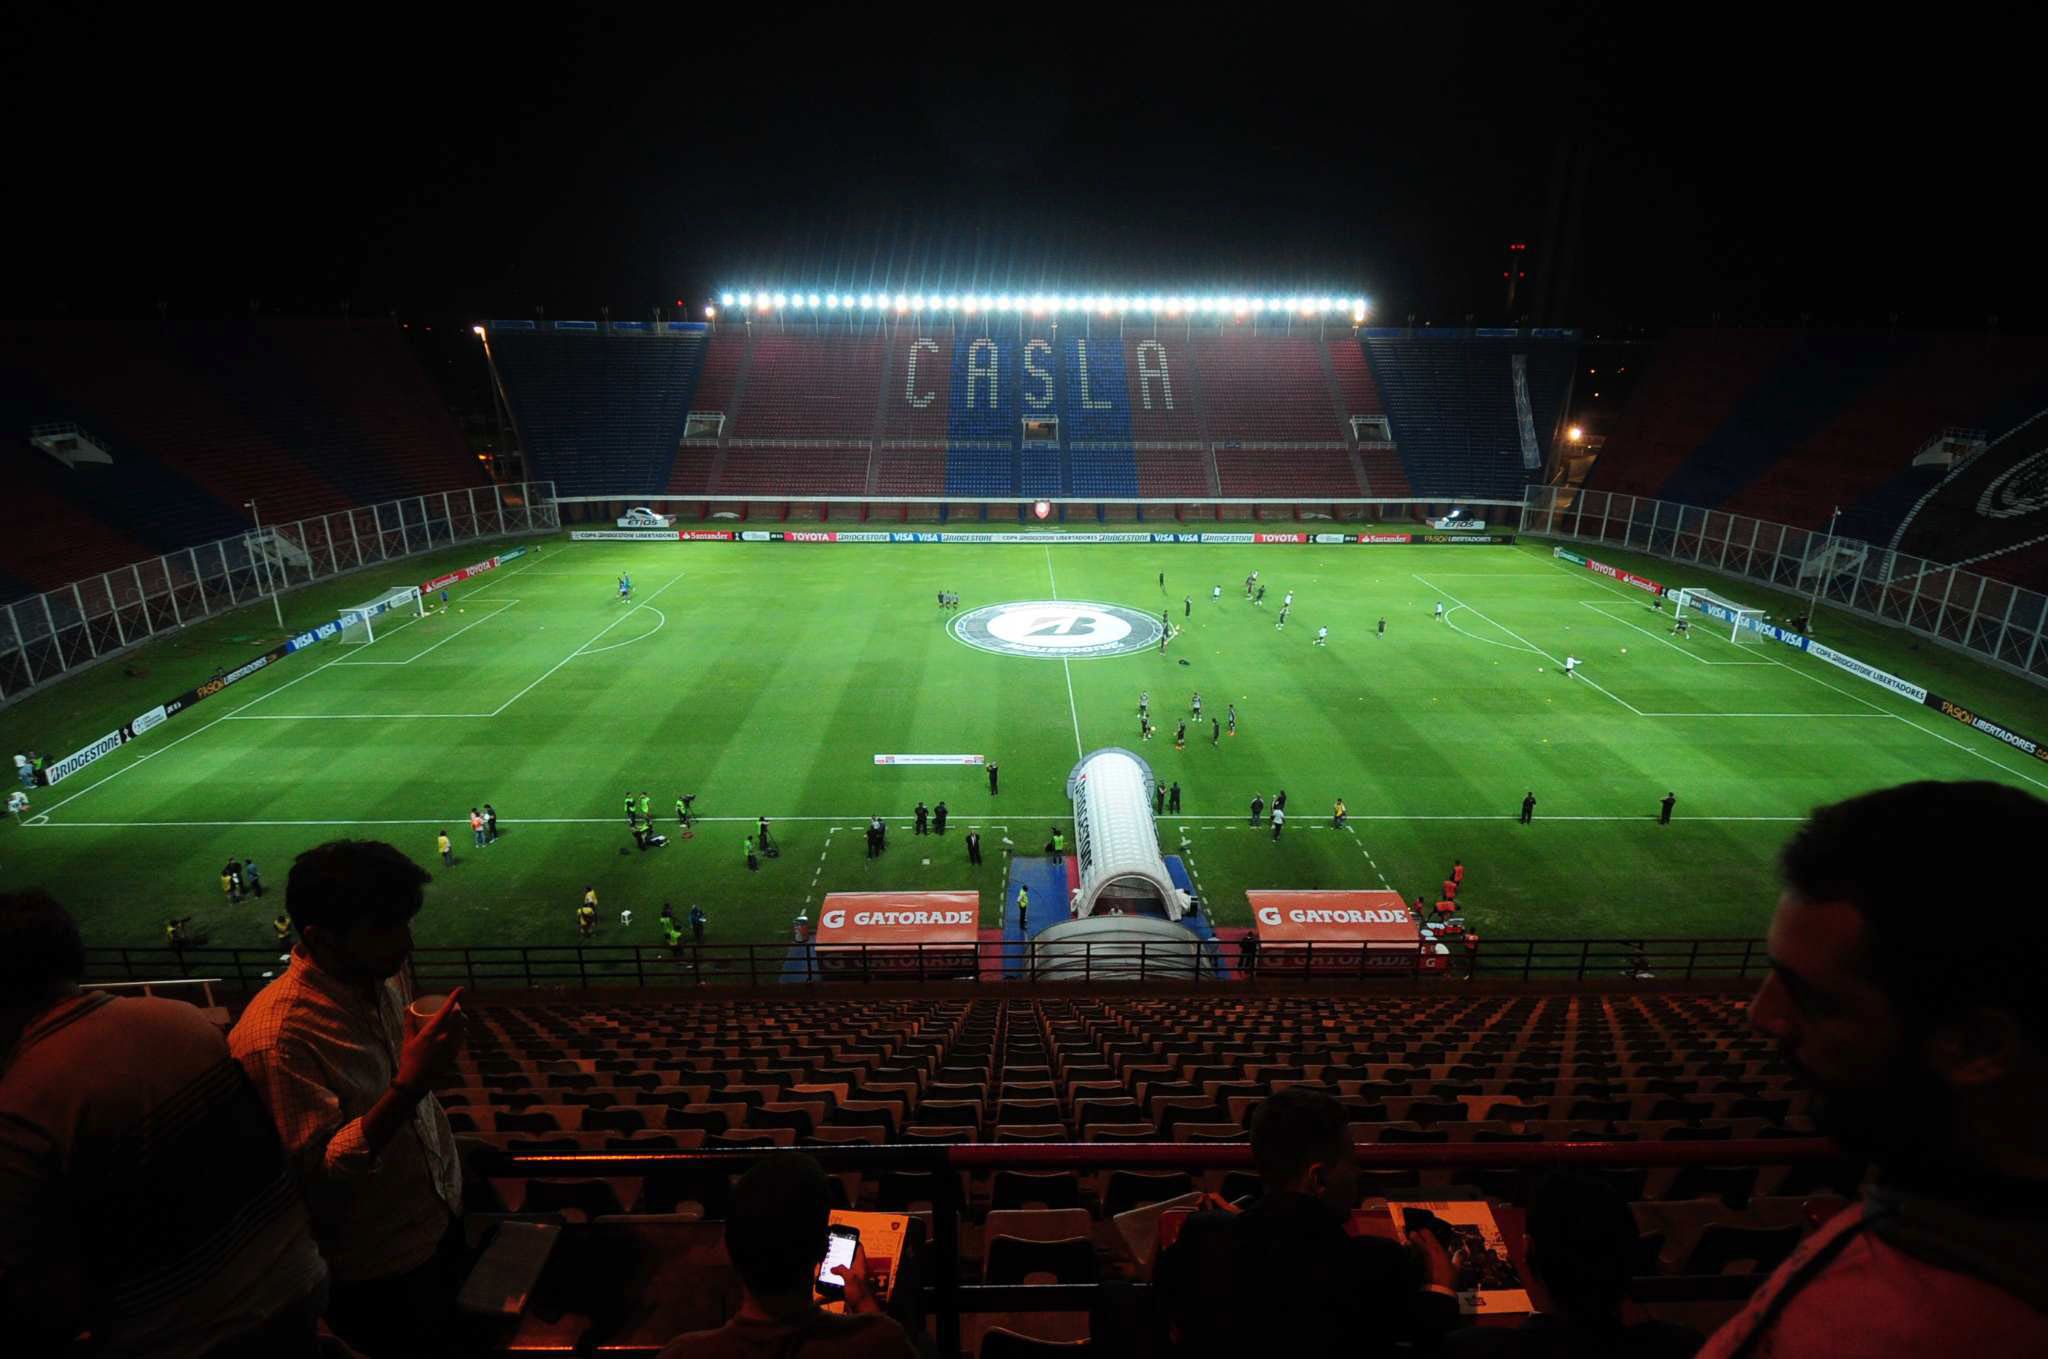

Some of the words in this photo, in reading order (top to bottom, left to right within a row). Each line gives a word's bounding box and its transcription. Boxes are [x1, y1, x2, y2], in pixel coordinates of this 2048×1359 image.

[906, 338, 1173, 409] CASLA
[1444, 520, 1474, 528] ETIOS
[690, 532, 729, 540] Santander
[792, 532, 829, 541] TOYOTA
[894, 532, 913, 541] VISA
[918, 532, 938, 541] VISA
[1154, 533, 1175, 542] VISA
[1178, 533, 1199, 542] VISA
[1261, 533, 1298, 542] TOYOTA
[1370, 534, 1407, 543] Santander
[466, 561, 491, 576] TOYOTA
[1591, 561, 1616, 577] TOYOTA
[1707, 604, 1727, 620] VISA
[339, 612, 359, 629] VISA
[1755, 619, 1777, 637] VISA
[315, 623, 337, 640] VISA
[1780, 629, 1803, 648] VISA
[292, 633, 315, 650] VISA
[1816, 646, 1832, 659] COPA
[1873, 671, 1924, 700] LIBERTADORES
[1972, 717, 2037, 753] LIBERTADORES
[51, 734, 120, 783] BRIDGESTONE
[823, 910, 846, 928] G
[854, 911, 975, 926] GATORADE
[1259, 907, 1282, 925] G
[1289, 909, 1409, 923] GATORADE
